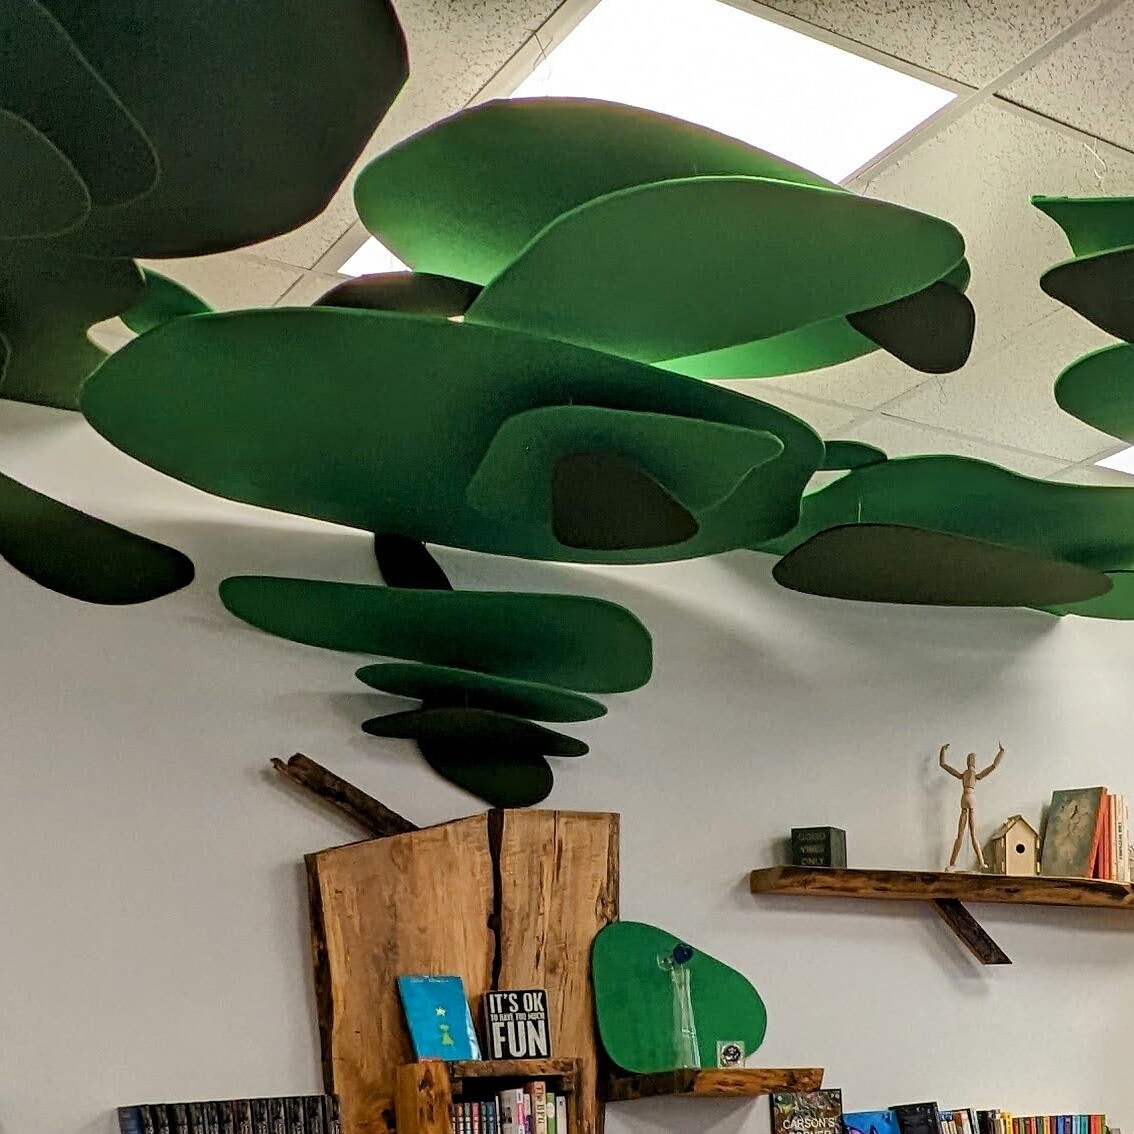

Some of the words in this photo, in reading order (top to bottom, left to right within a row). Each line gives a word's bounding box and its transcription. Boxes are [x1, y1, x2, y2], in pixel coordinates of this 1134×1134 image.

[489, 992, 519, 1013] IT'S
[522, 991, 545, 1012] OK
[490, 1014, 498, 1022] TO
[500, 1013, 514, 1022] HAVE
[515, 1012, 526, 1020] TOO
[528, 1012, 545, 1020] MUCH
[492, 1020, 548, 1058] FUN
[536, 1104, 545, 1124] BFG
[782, 1118, 836, 1130] CARSON'S
